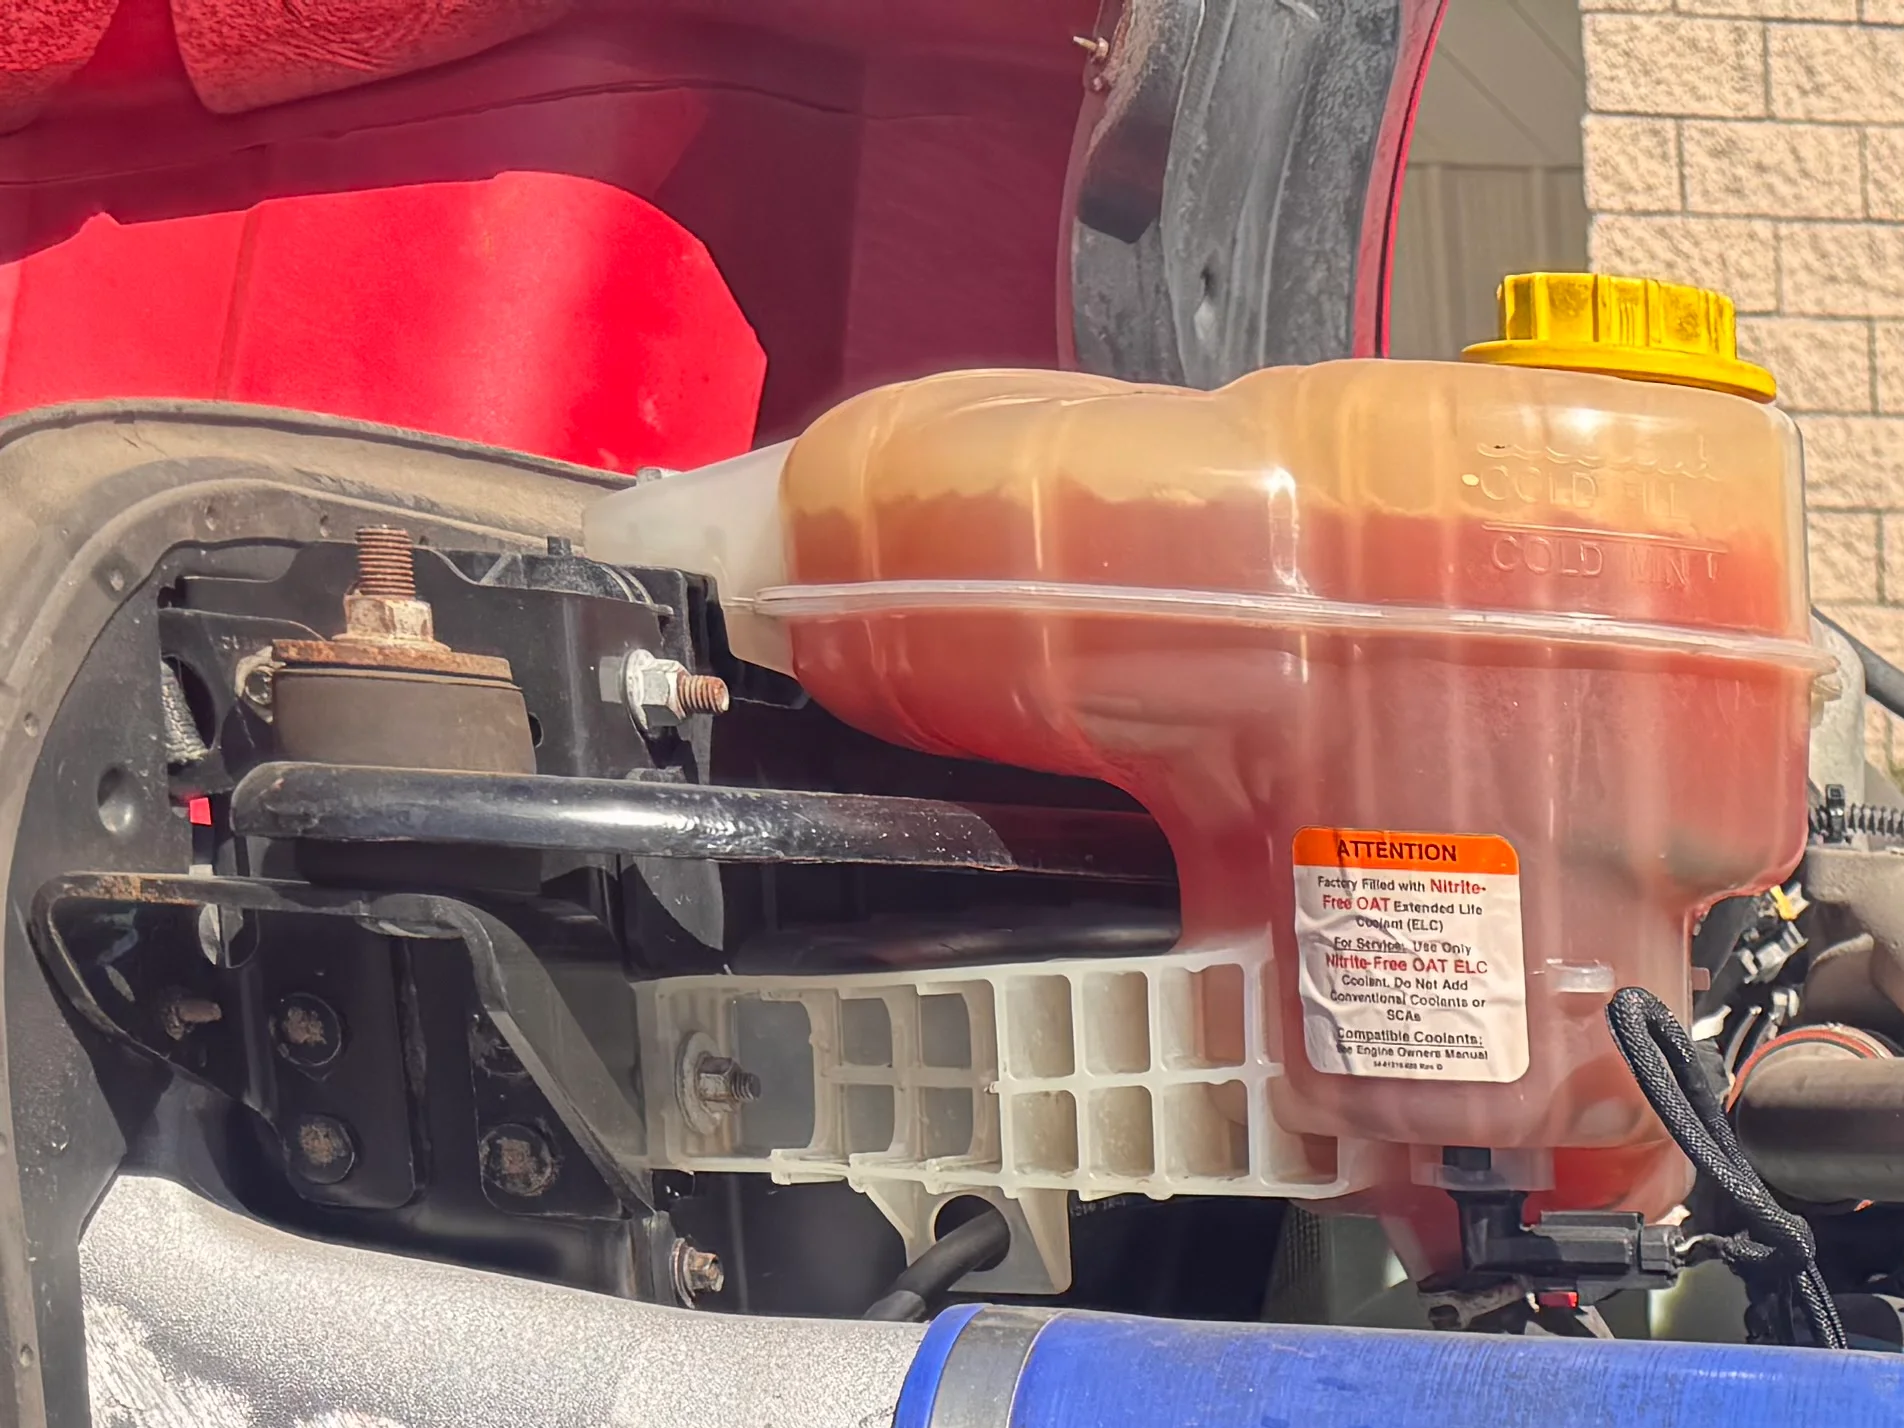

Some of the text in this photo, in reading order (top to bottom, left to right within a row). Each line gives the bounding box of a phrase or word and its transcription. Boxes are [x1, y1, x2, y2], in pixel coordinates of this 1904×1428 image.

[1480, 466, 1598, 508] COLD
[1491, 536, 1604, 577] COLD
[1337, 839, 1457, 862] ATTENTION
[1318, 876, 1486, 894] Factory Filled with Nitrite-
[1322, 895, 1483, 915] Free OAT Extended Life
[1407, 920, 1444, 934] (ELC)
[1334, 937, 1352, 950] For
[1413, 940, 1437, 953] Use
[1441, 942, 1472, 956] Only
[1413, 958, 1447, 973] OAT
[1454, 960, 1488, 974] ELC
[1394, 977, 1411, 989] Do
[1415, 978, 1438, 990] Not
[1442, 979, 1468, 991] Add
[1330, 990, 1485, 1007] Conventional Coolants or
[1387, 1009, 1421, 1022] SCAs
[1337, 1027, 1483, 1045] Compatible Coolants:
[1357, 1045, 1394, 1059] Engine
[1397, 1047, 1441, 1059] Owners
[1445, 1049, 1488, 1060] Manual
